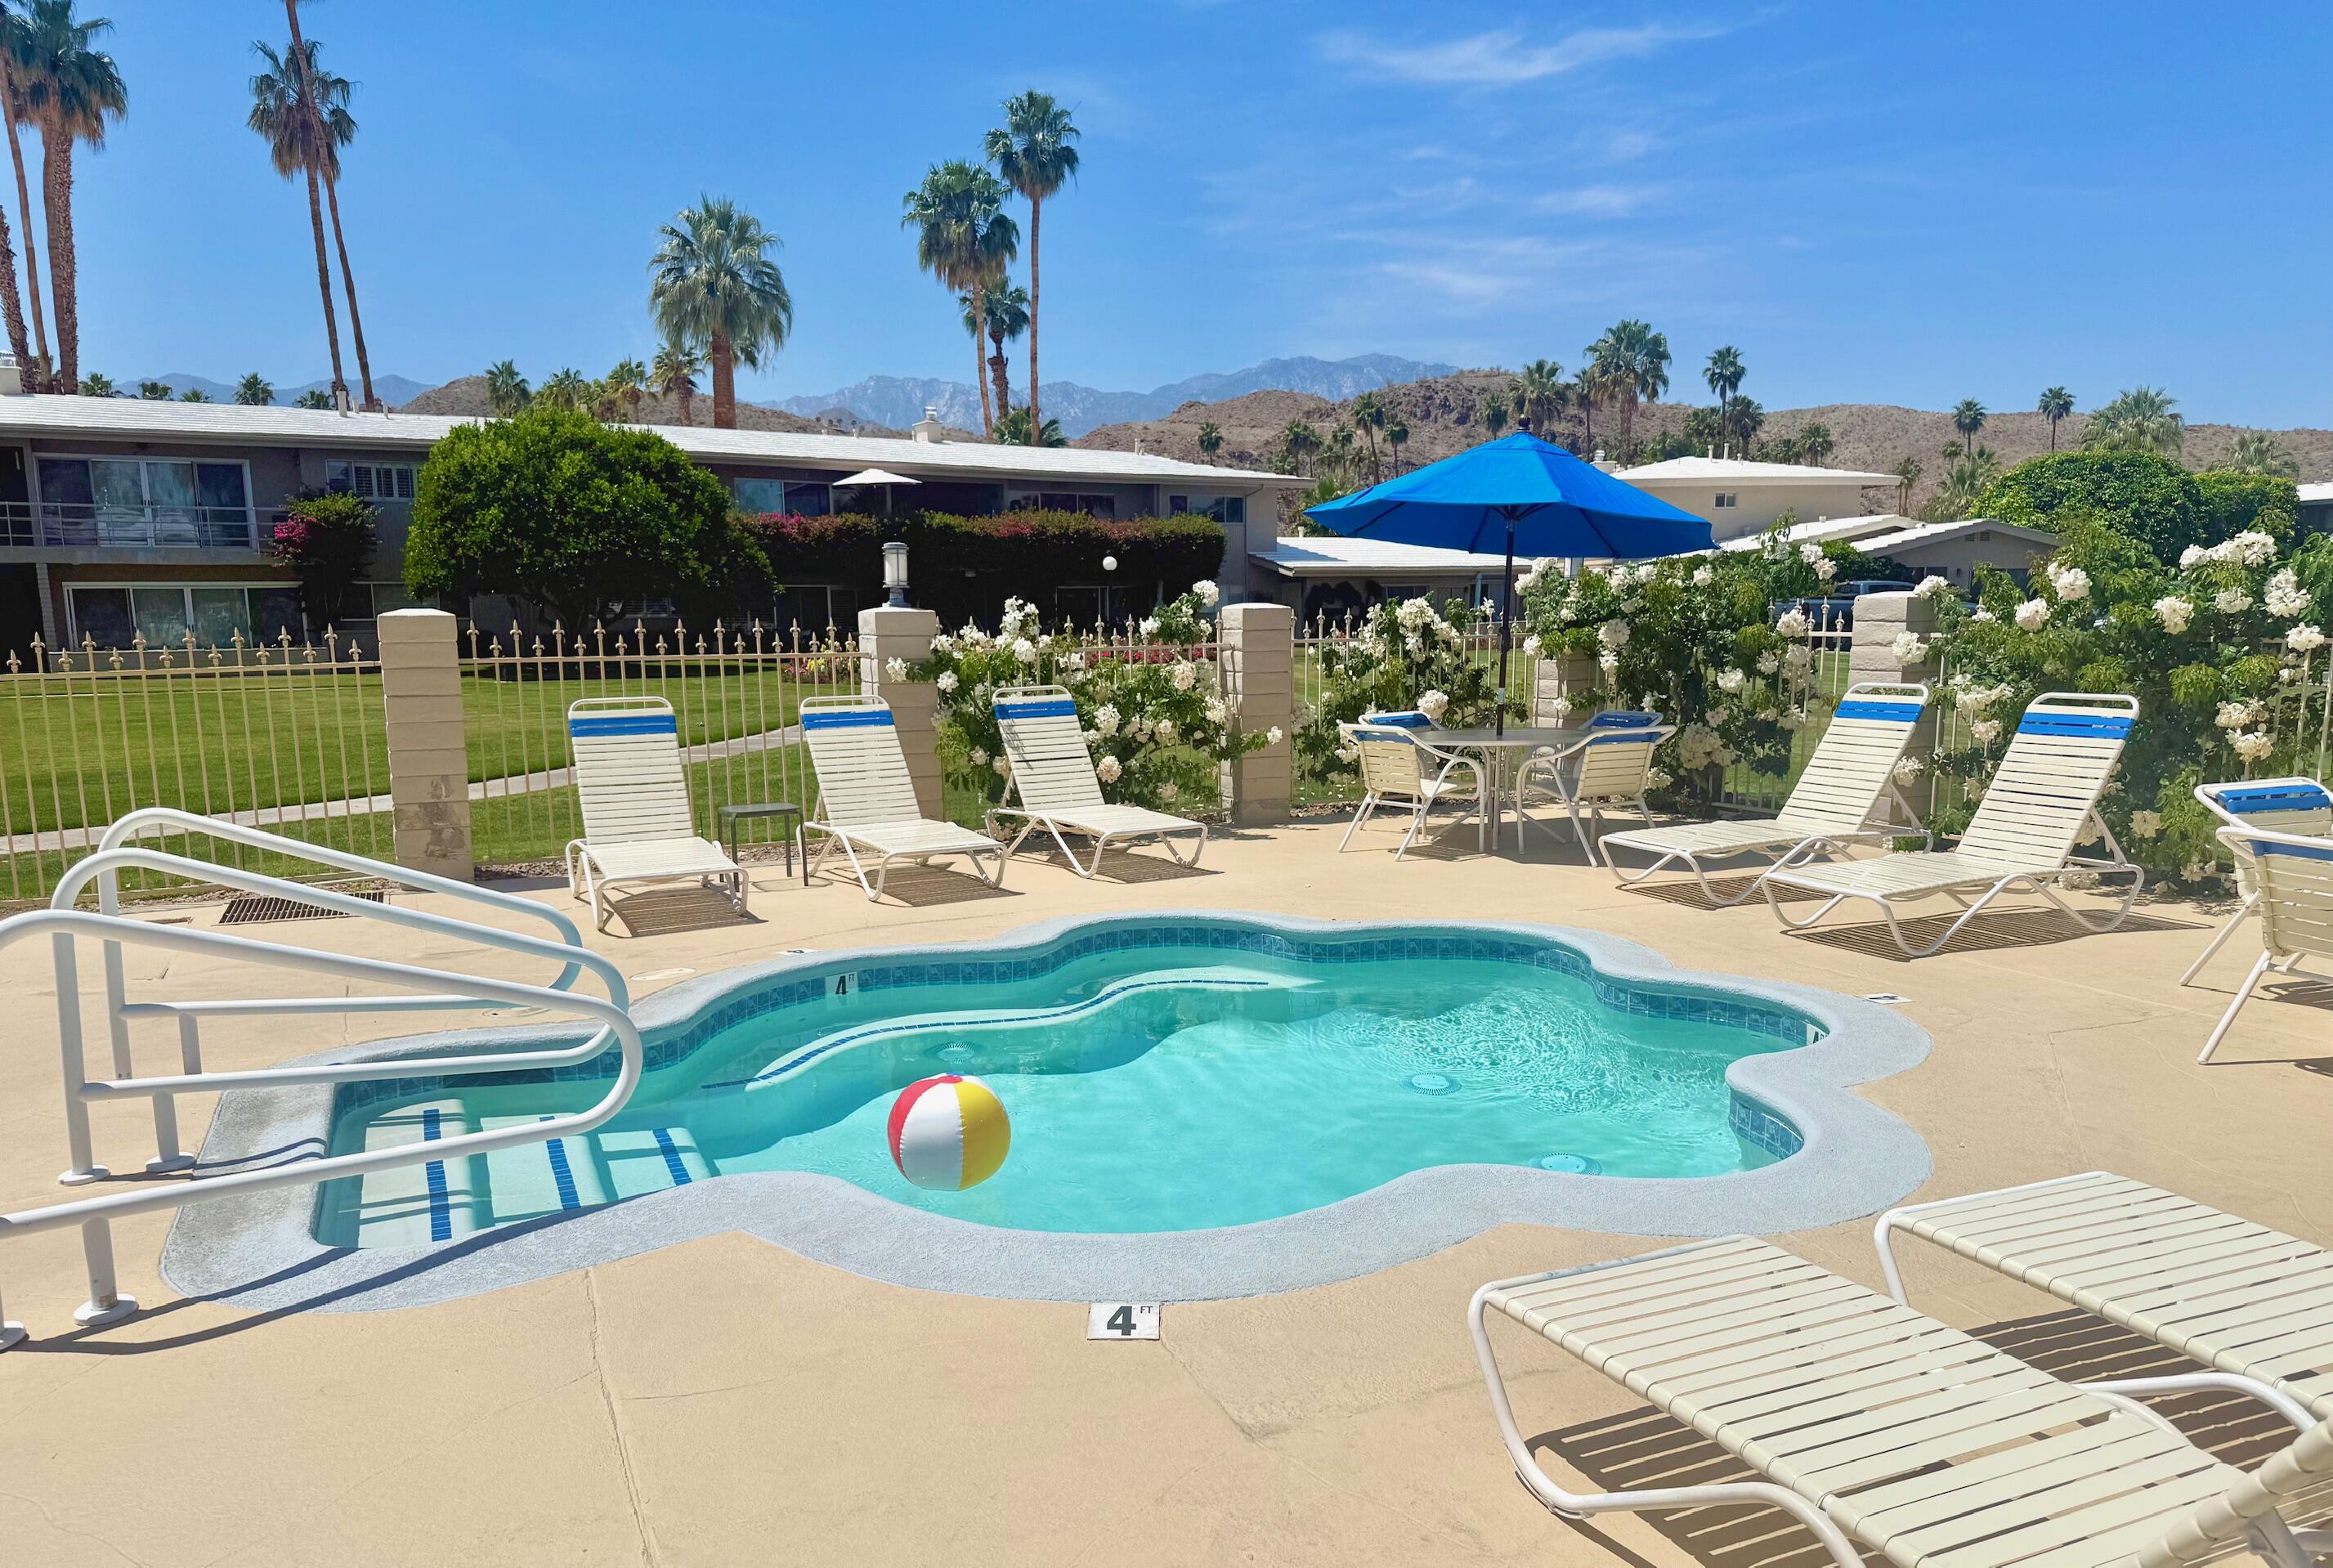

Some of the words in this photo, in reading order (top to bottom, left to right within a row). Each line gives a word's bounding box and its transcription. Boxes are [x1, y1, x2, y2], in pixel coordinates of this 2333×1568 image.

[835, 975, 849, 995] 4
[849, 973, 855, 982] FT
[1106, 1306, 1137, 1336] 4
[1140, 1306, 1153, 1314] FT
